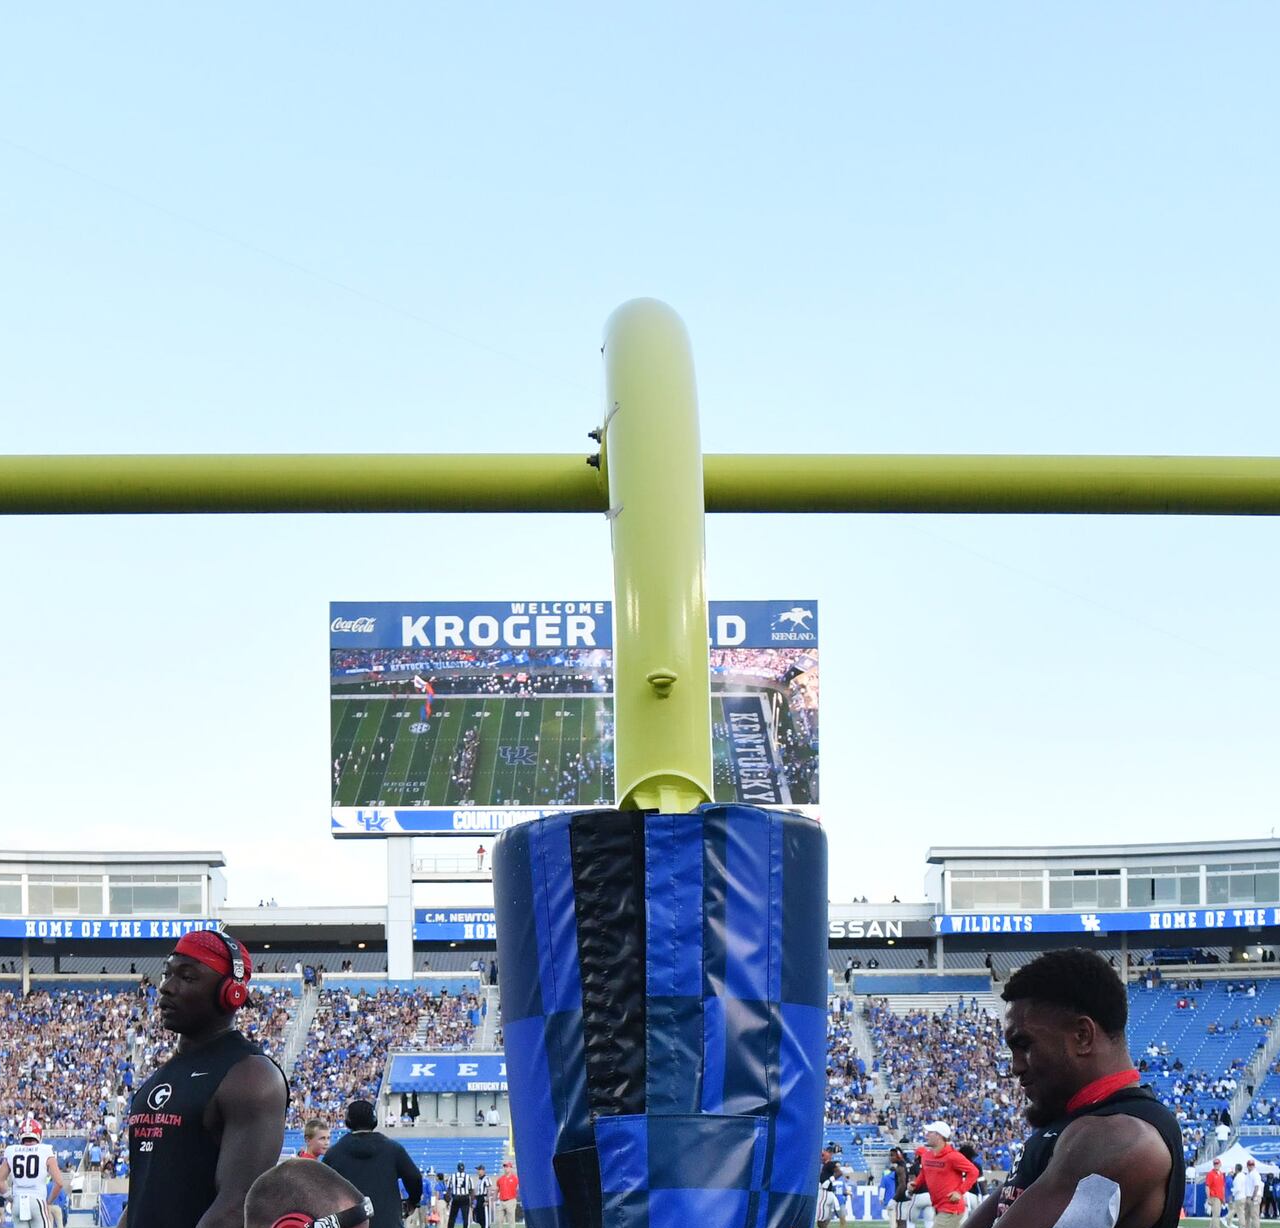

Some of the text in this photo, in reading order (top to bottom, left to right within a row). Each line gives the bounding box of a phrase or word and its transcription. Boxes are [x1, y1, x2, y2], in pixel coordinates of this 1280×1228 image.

[511, 602, 605, 614] WELCOME
[402, 615, 596, 647] KROGER
[771, 632, 814, 641] KEENELAND
[729, 712, 776, 803] KENTUCKY
[425, 913, 448, 923] C.M.
[951, 915, 1033, 932] WILDCATS
[1149, 912, 1197, 929] HOME
[1205, 911, 1225, 928] OF
[1233, 908, 1266, 926] THE
[25, 921, 73, 938] HOME
[81, 921, 101, 938] OF
[110, 921, 141, 938] THE
[464, 924, 497, 939] HOM
[829, 920, 903, 938] SSAN
[13, 1155, 39, 1179] 60
